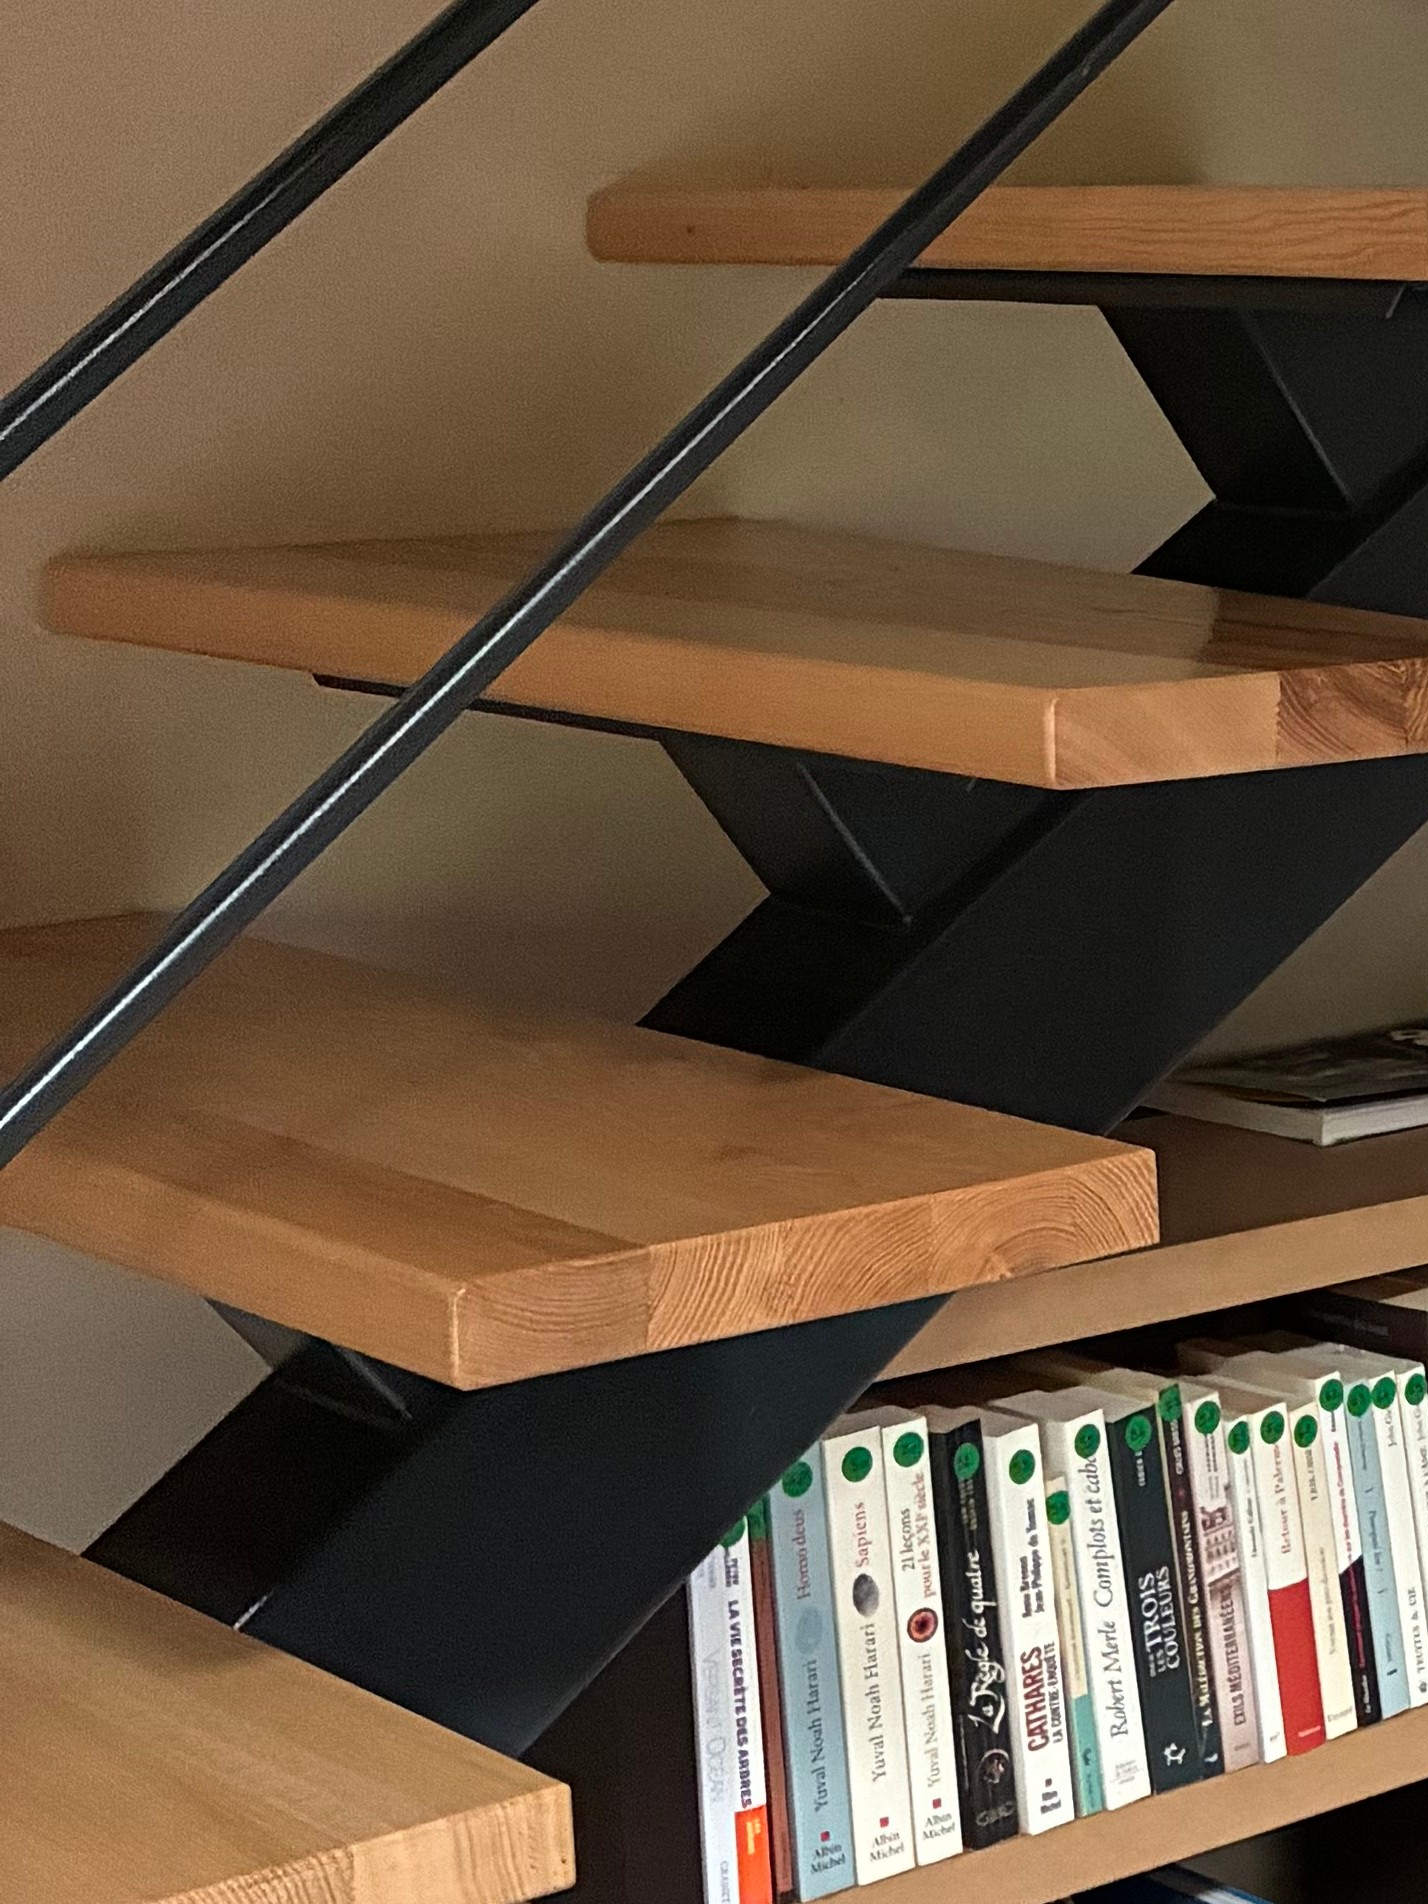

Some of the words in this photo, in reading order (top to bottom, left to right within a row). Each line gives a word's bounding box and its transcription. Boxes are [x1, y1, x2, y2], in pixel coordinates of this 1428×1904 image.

[792, 1507, 807, 1554] deus
[854, 1500, 872, 1570] Sapiens
[899, 1508, 916, 1557] leçons
[1085, 1501, 1102, 1524] et
[796, 1556, 812, 1601] Homo
[901, 1558, 916, 1574] 21
[922, 1563, 937, 1599] pour
[966, 1548, 998, 1615] quatre
[1086, 1526, 1113, 1609] Complots
[728, 1599, 741, 1620] LA
[962, 1617, 989, 1638] de
[1138, 1572, 1162, 1652] TROIS
[1155, 1565, 1181, 1670] COULEURS
[729, 1621, 743, 1650] VIE
[864, 1622, 882, 1681] Harari
[1100, 1620, 1122, 1673] Merle
[731, 1650, 749, 1716] SECRÈTE
[808, 1658, 824, 1723] Harari
[920, 1651, 938, 1700] Harari
[964, 1641, 1006, 1707] Règle
[868, 1683, 885, 1731] Noah
[923, 1700, 941, 1740] Noah
[967, 1693, 1006, 1735] La
[1020, 1645, 1050, 1753] CATHARES
[1103, 1685, 1130, 1738] Robert
[1200, 1707, 1213, 1727] LA
[1230, 1693, 1246, 1725] EXILS
[736, 1717, 750, 1749] DES
[811, 1725, 828, 1771] Noah
[1050, 1729, 1063, 1744] LA
[737, 1749, 752, 1810] ARBRES
[871, 1733, 890, 1784] Yuval
[926, 1741, 943, 1789] Yuval
[813, 1772, 831, 1815] Yuval
[869, 1840, 906, 1862] Michel
[922, 1821, 957, 1843] Michel
